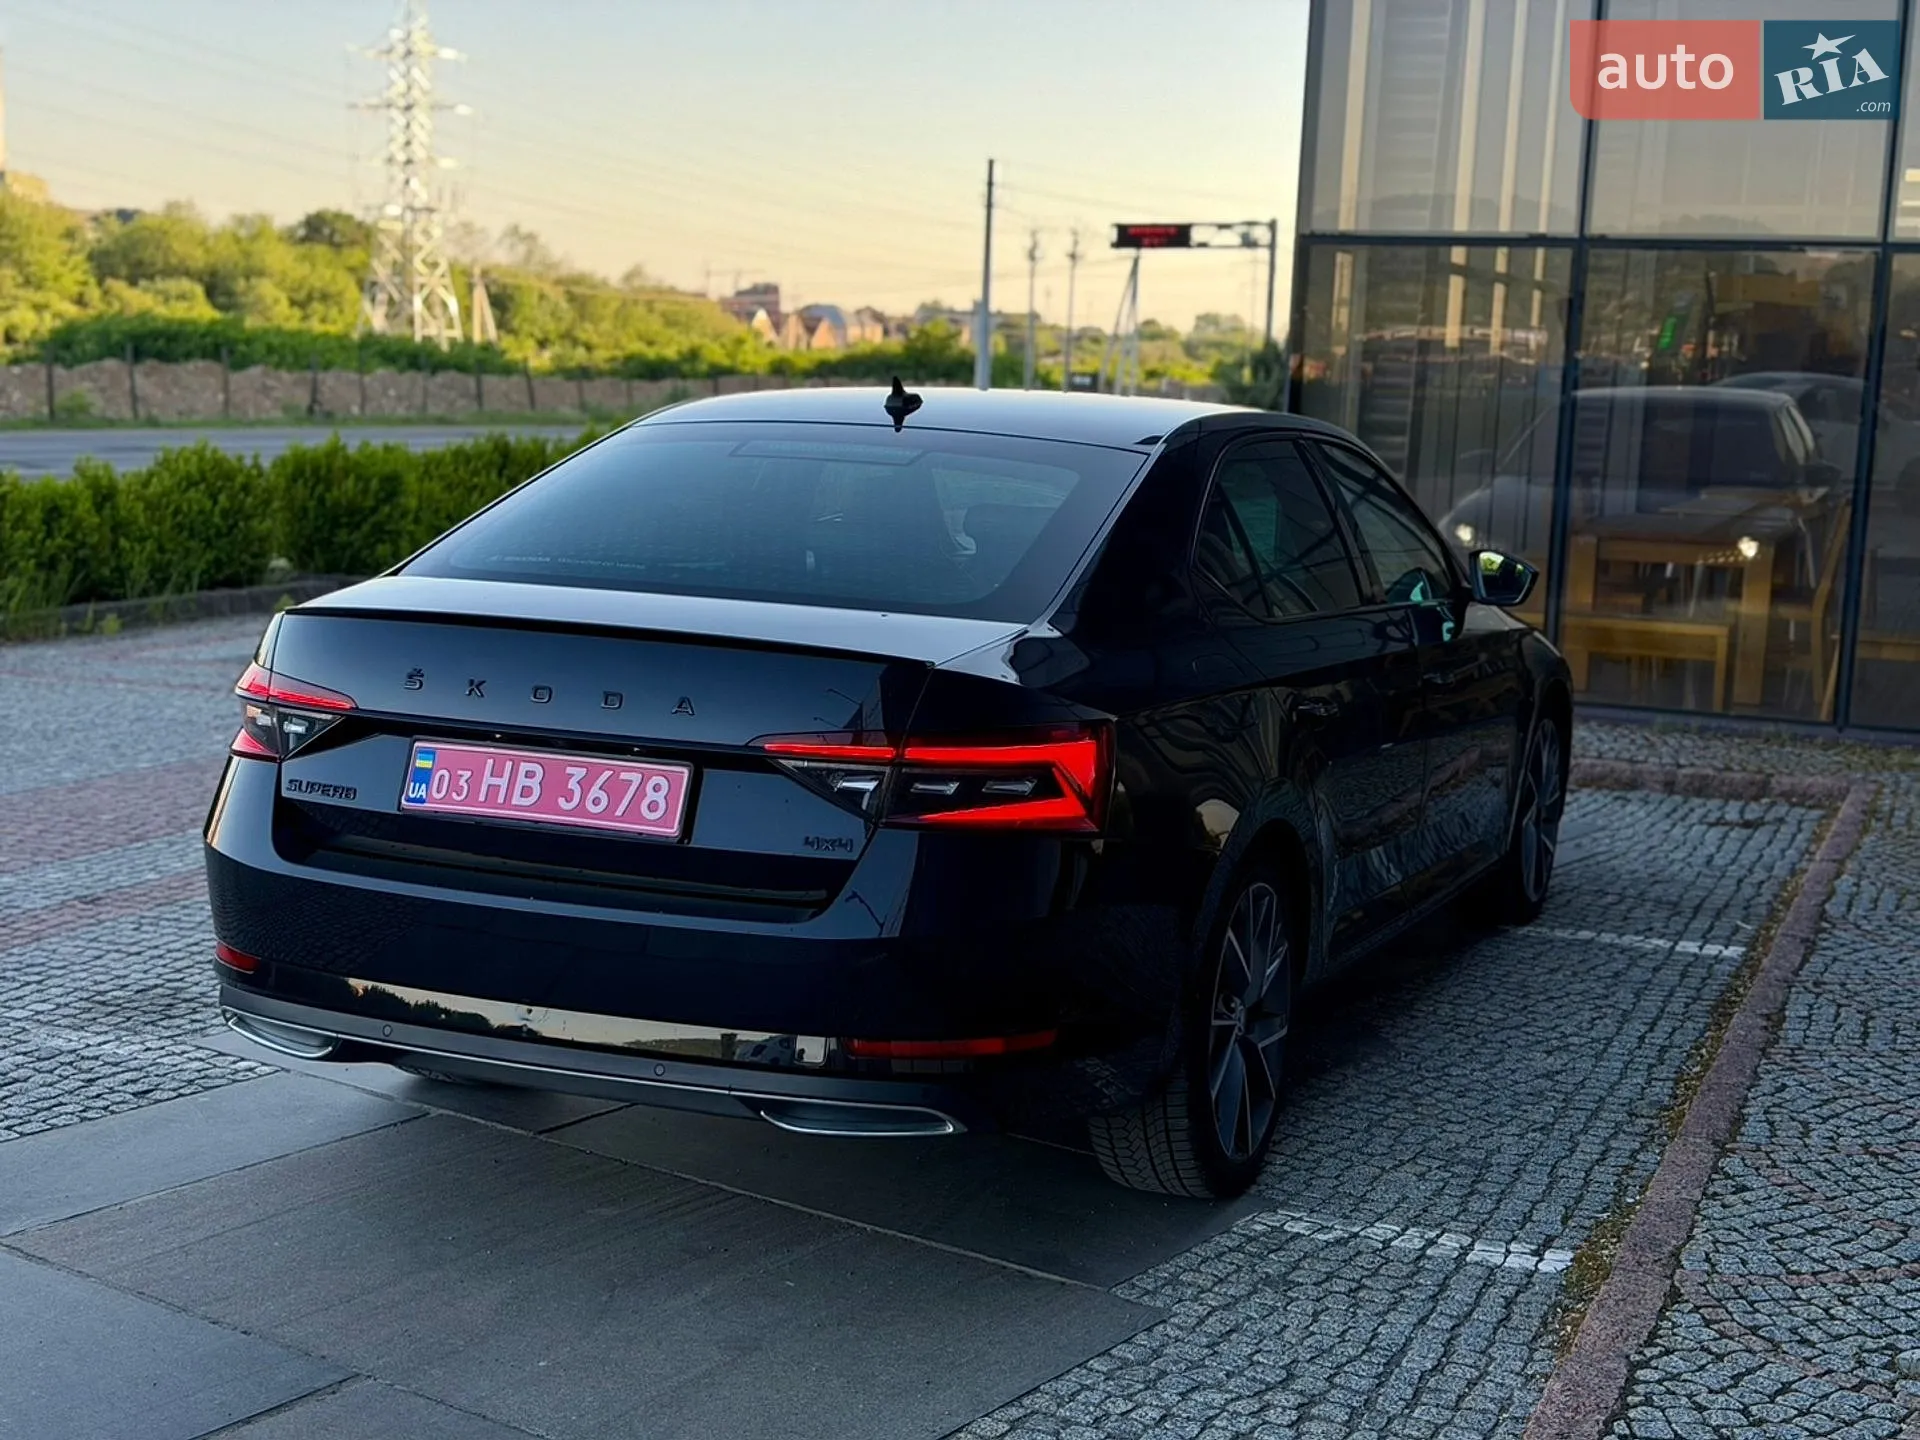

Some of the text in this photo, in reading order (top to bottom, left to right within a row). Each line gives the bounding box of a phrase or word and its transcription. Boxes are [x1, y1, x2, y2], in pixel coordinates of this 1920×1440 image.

[404, 668, 695, 716] ŠKODA
[286, 778, 357, 801] SUPERB
[409, 782, 427, 799] UA
[431, 758, 670, 821] 03 HB 3678
